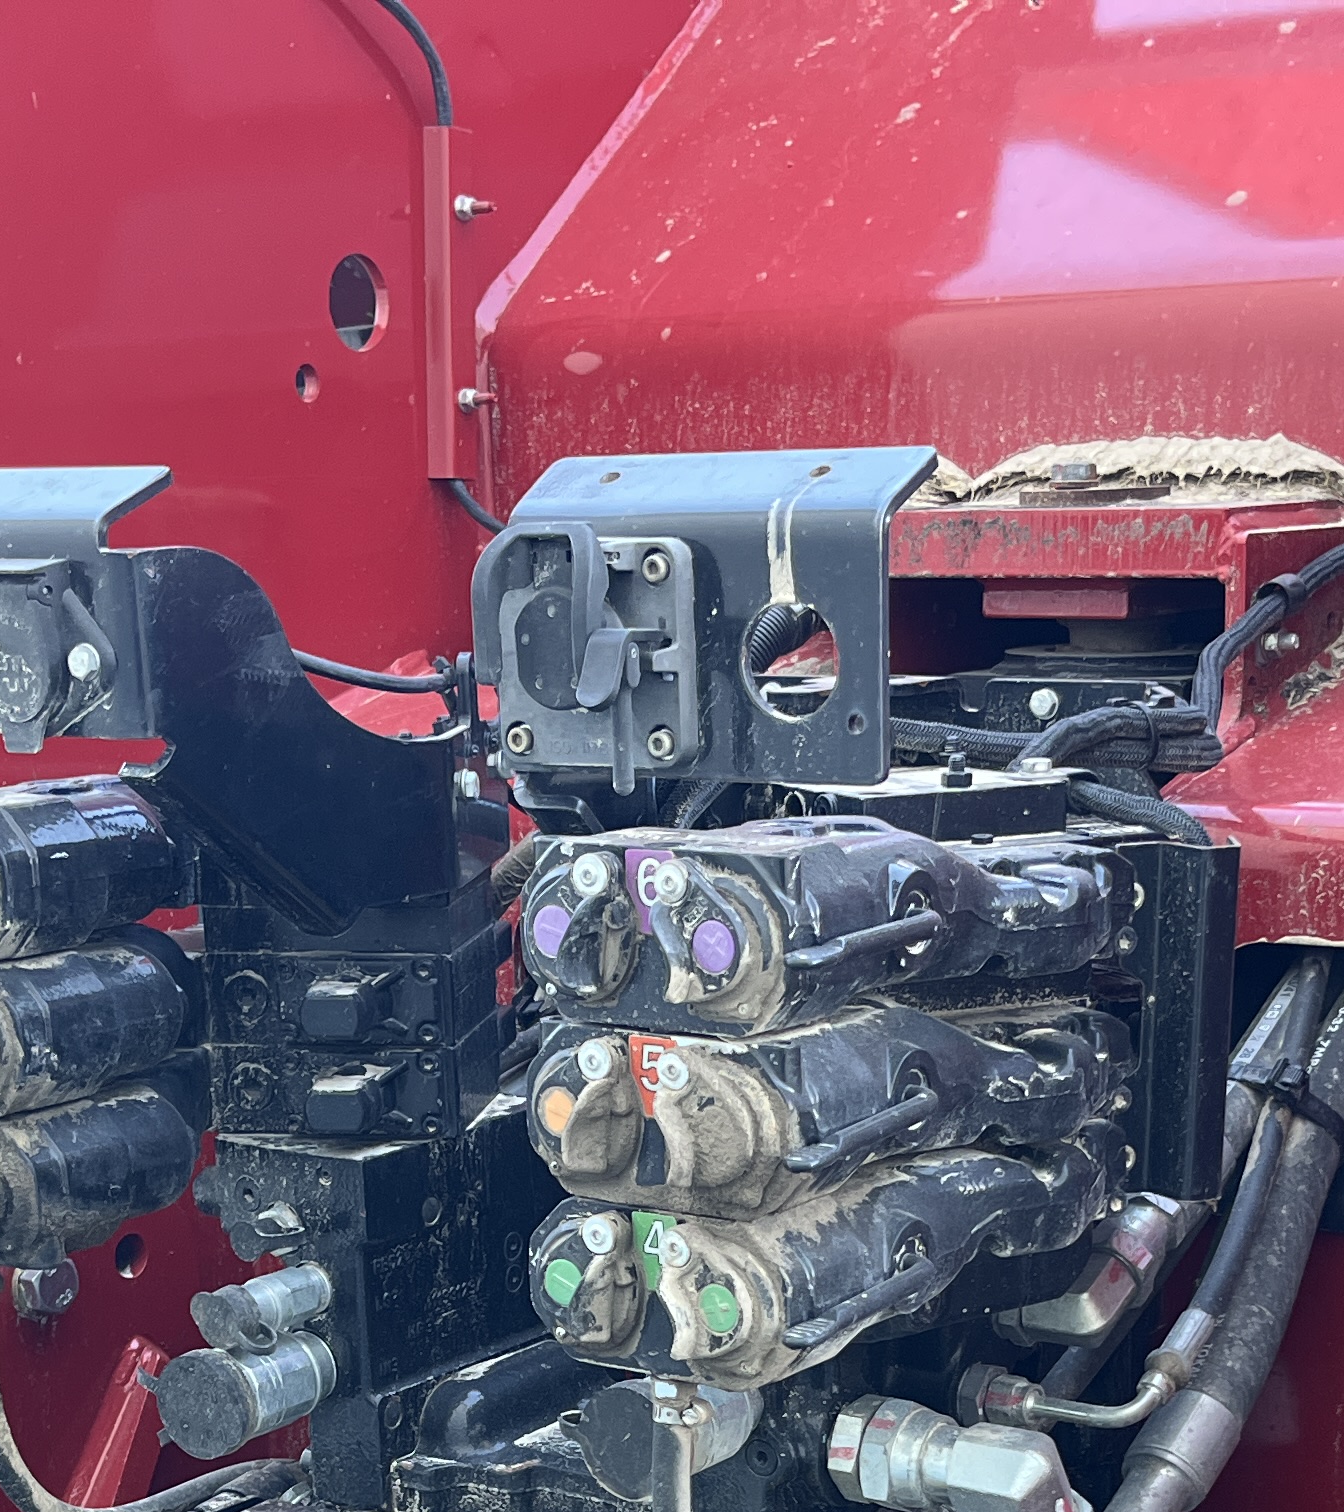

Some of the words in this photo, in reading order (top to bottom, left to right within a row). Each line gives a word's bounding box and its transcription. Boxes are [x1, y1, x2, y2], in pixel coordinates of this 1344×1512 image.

[637, 857, 661, 907] 6
[640, 1044, 665, 1092] 5
[643, 1220, 664, 1267] 4
